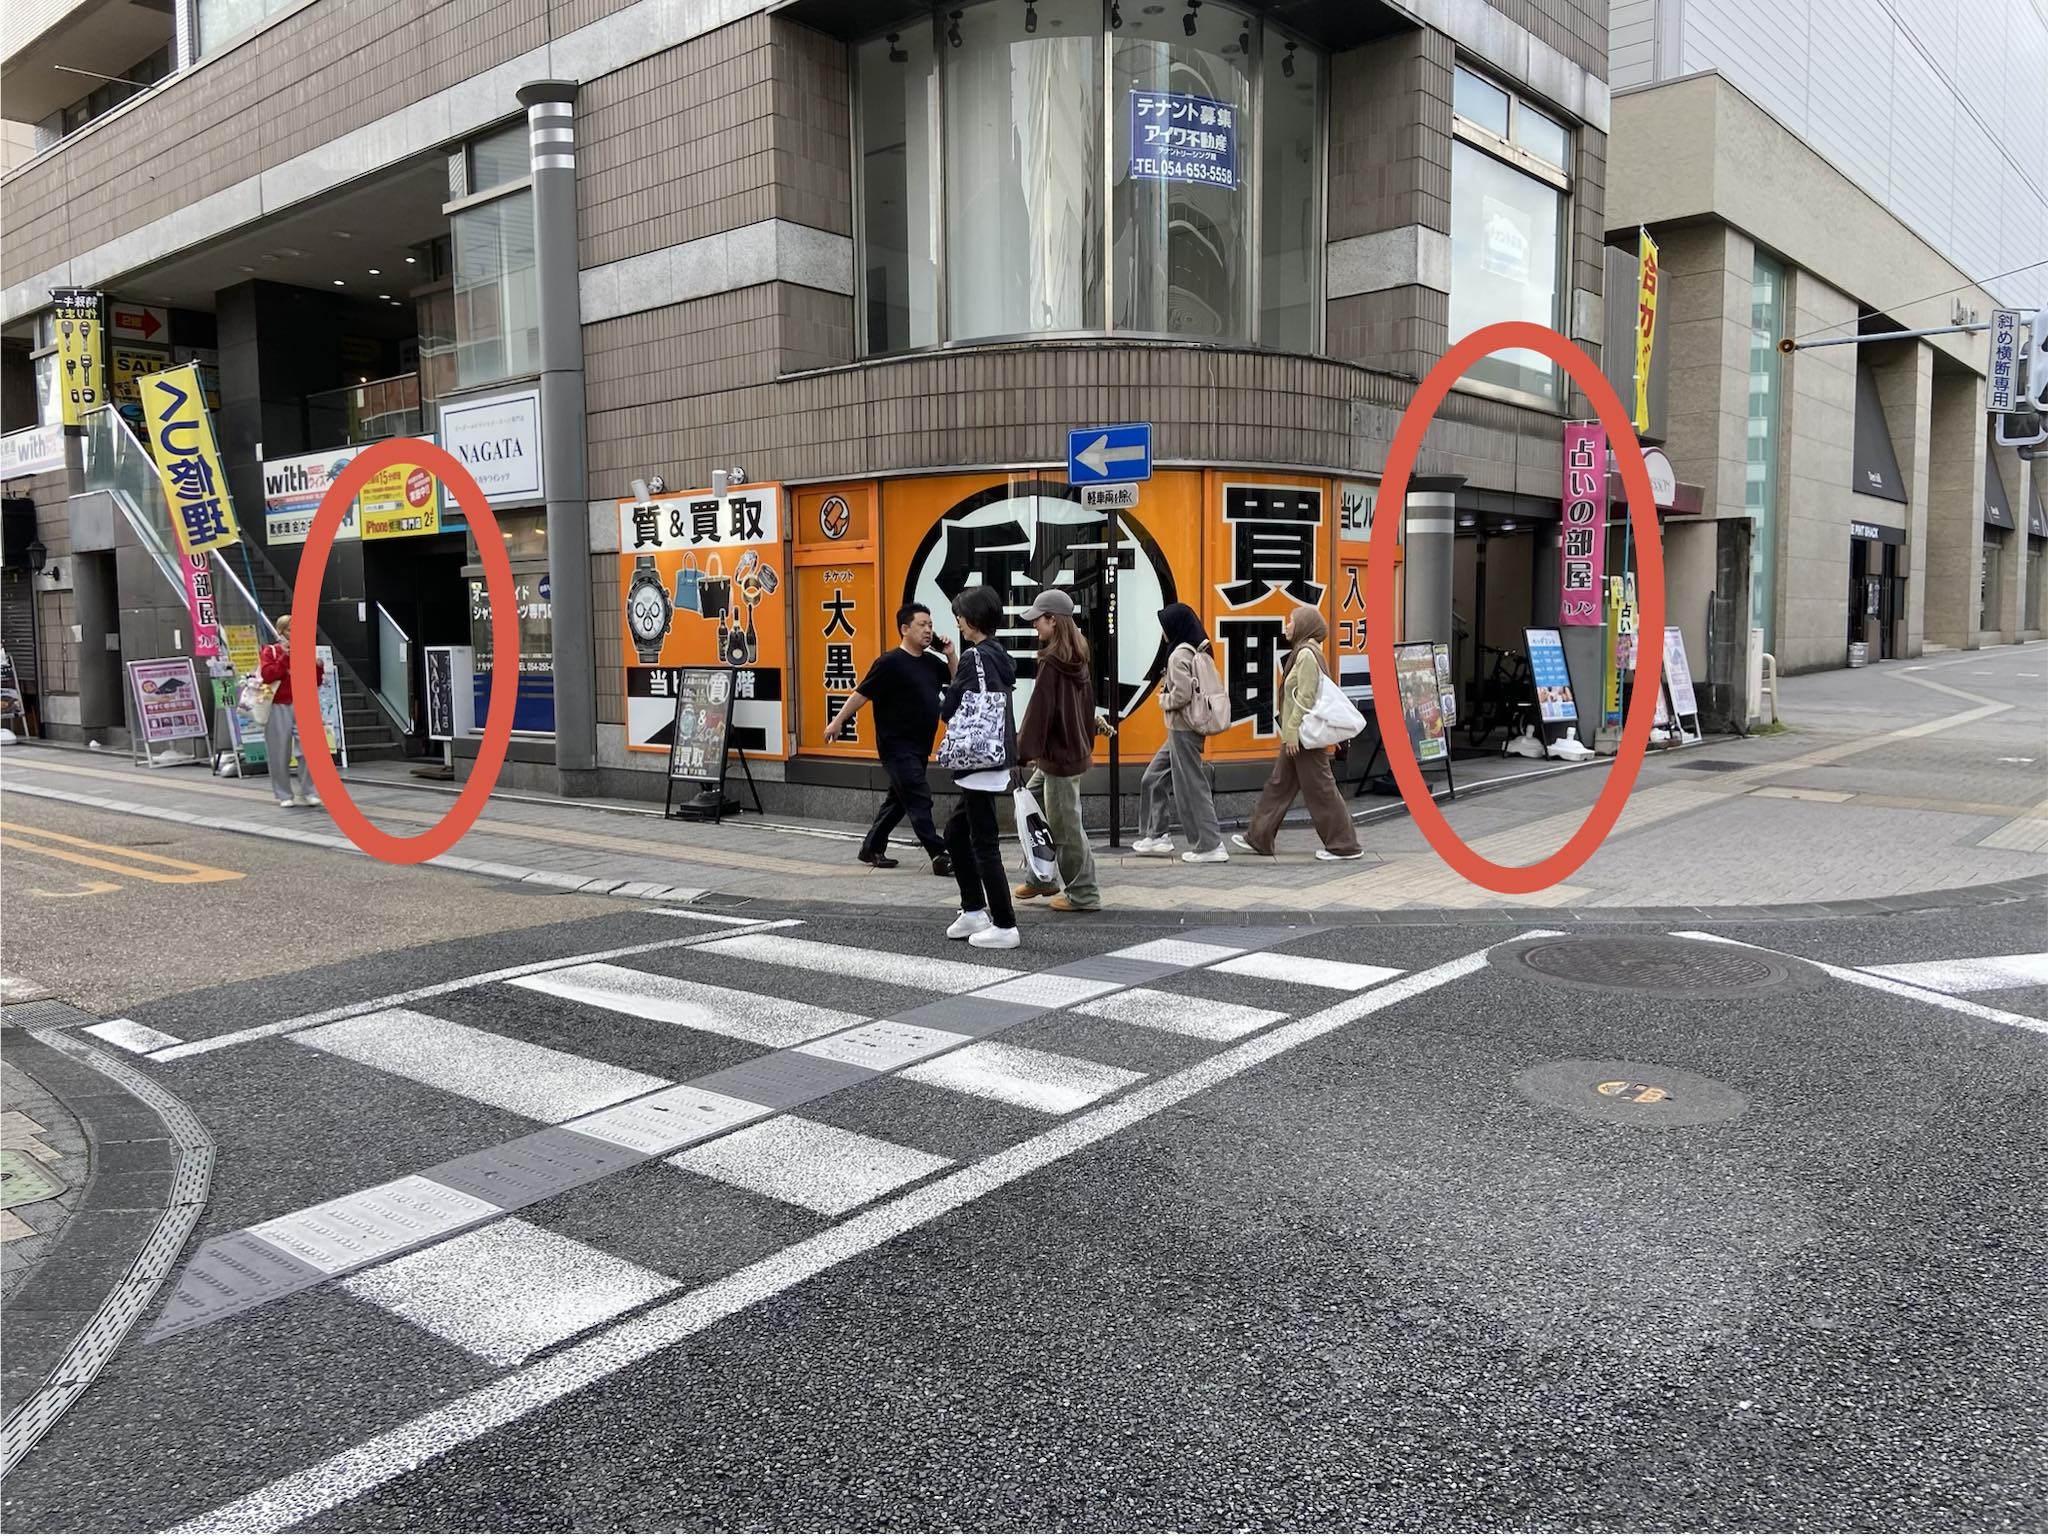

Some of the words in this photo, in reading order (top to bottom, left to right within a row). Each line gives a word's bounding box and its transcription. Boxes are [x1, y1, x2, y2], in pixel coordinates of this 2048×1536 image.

[1137, 98, 1232, 128] テナント募集
[1144, 125, 1227, 152] アイワ不動産
[1136, 158, 1159, 174] TEL
[1161, 160, 1233, 184] 054-653-5558
[1993, 314, 2014, 407] 斜め横断専用
[18, 434, 46, 462] with
[459, 437, 523, 463] NAGATA
[266, 464, 308, 495] with
[1566, 438, 1596, 592] 占いの部屋
[823, 569, 855, 583] チケット
[821, 588, 859, 742] 大黒屋
[430, 654, 441, 732] NAGATA
